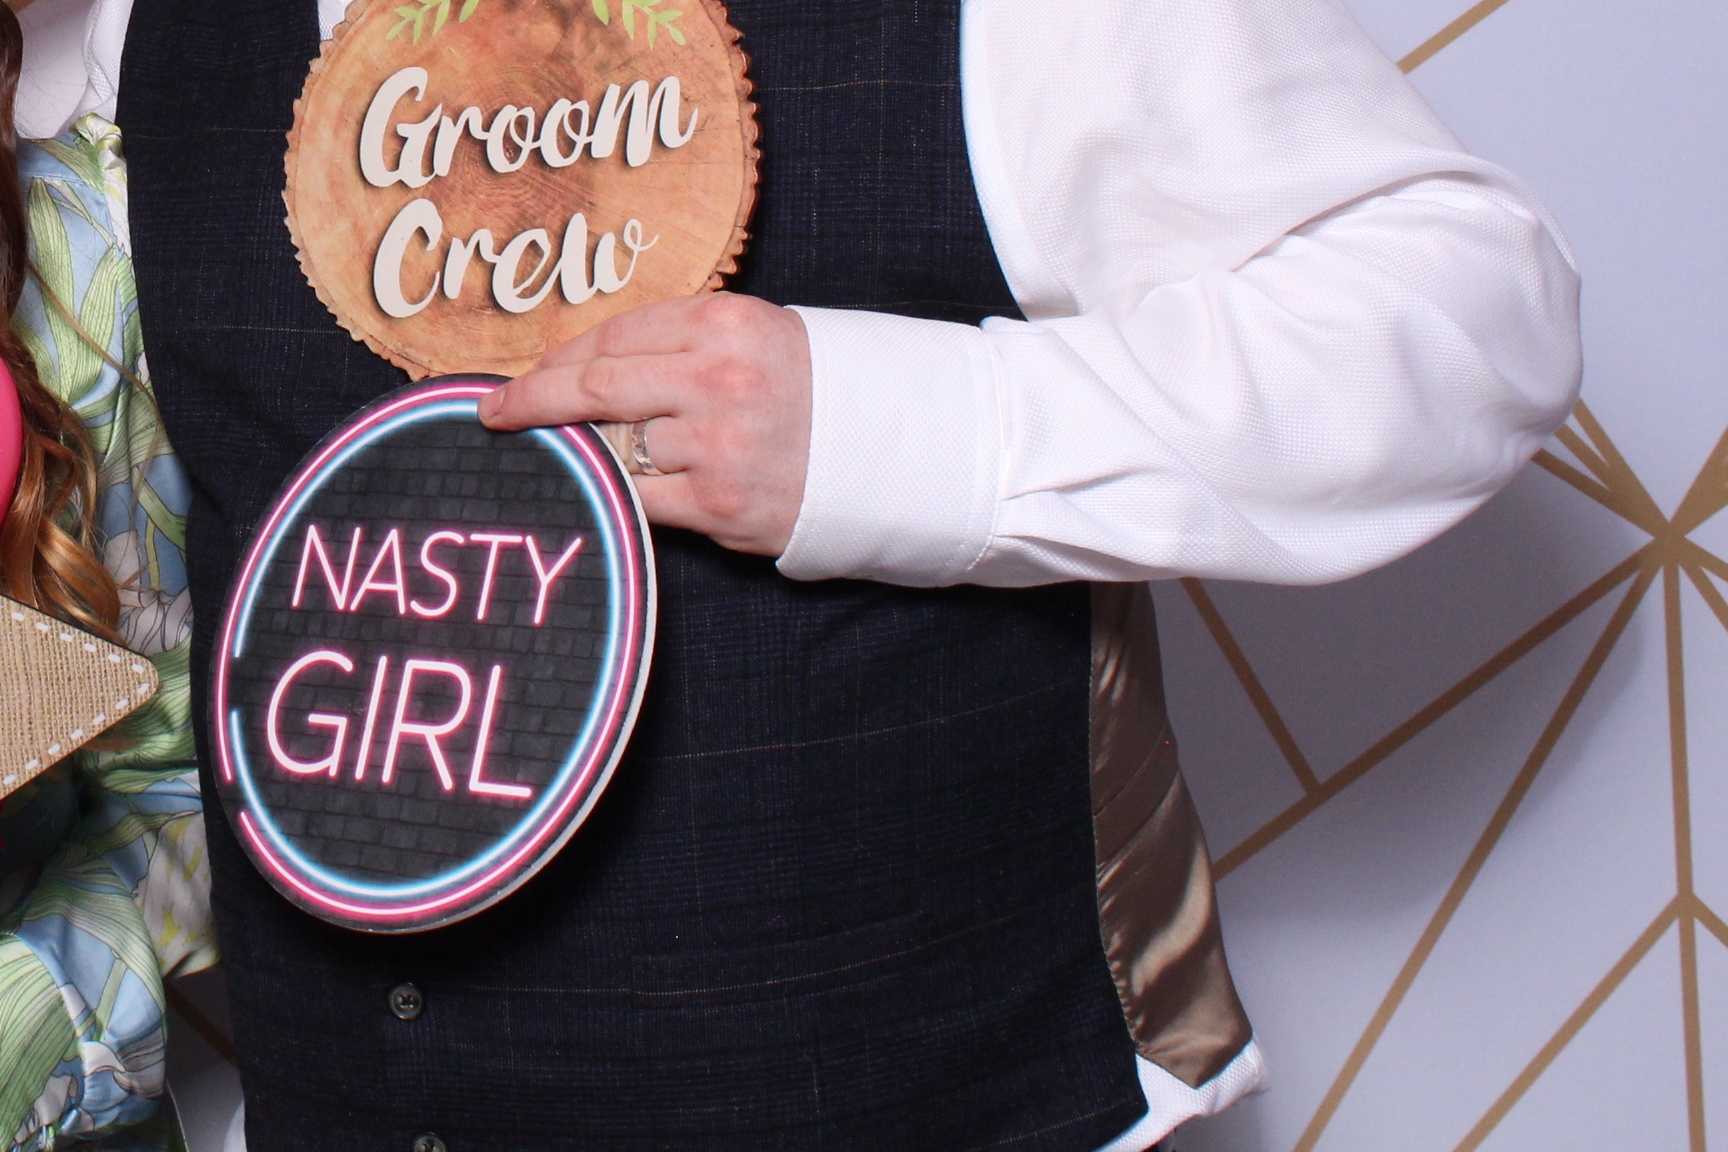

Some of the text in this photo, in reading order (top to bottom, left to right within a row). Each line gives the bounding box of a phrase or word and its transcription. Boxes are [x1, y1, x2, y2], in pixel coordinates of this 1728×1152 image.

[359, 66, 698, 189] Groom
[373, 198, 659, 319] Crew
[290, 524, 582, 625] NASTY
[266, 649, 533, 800] GIRL
